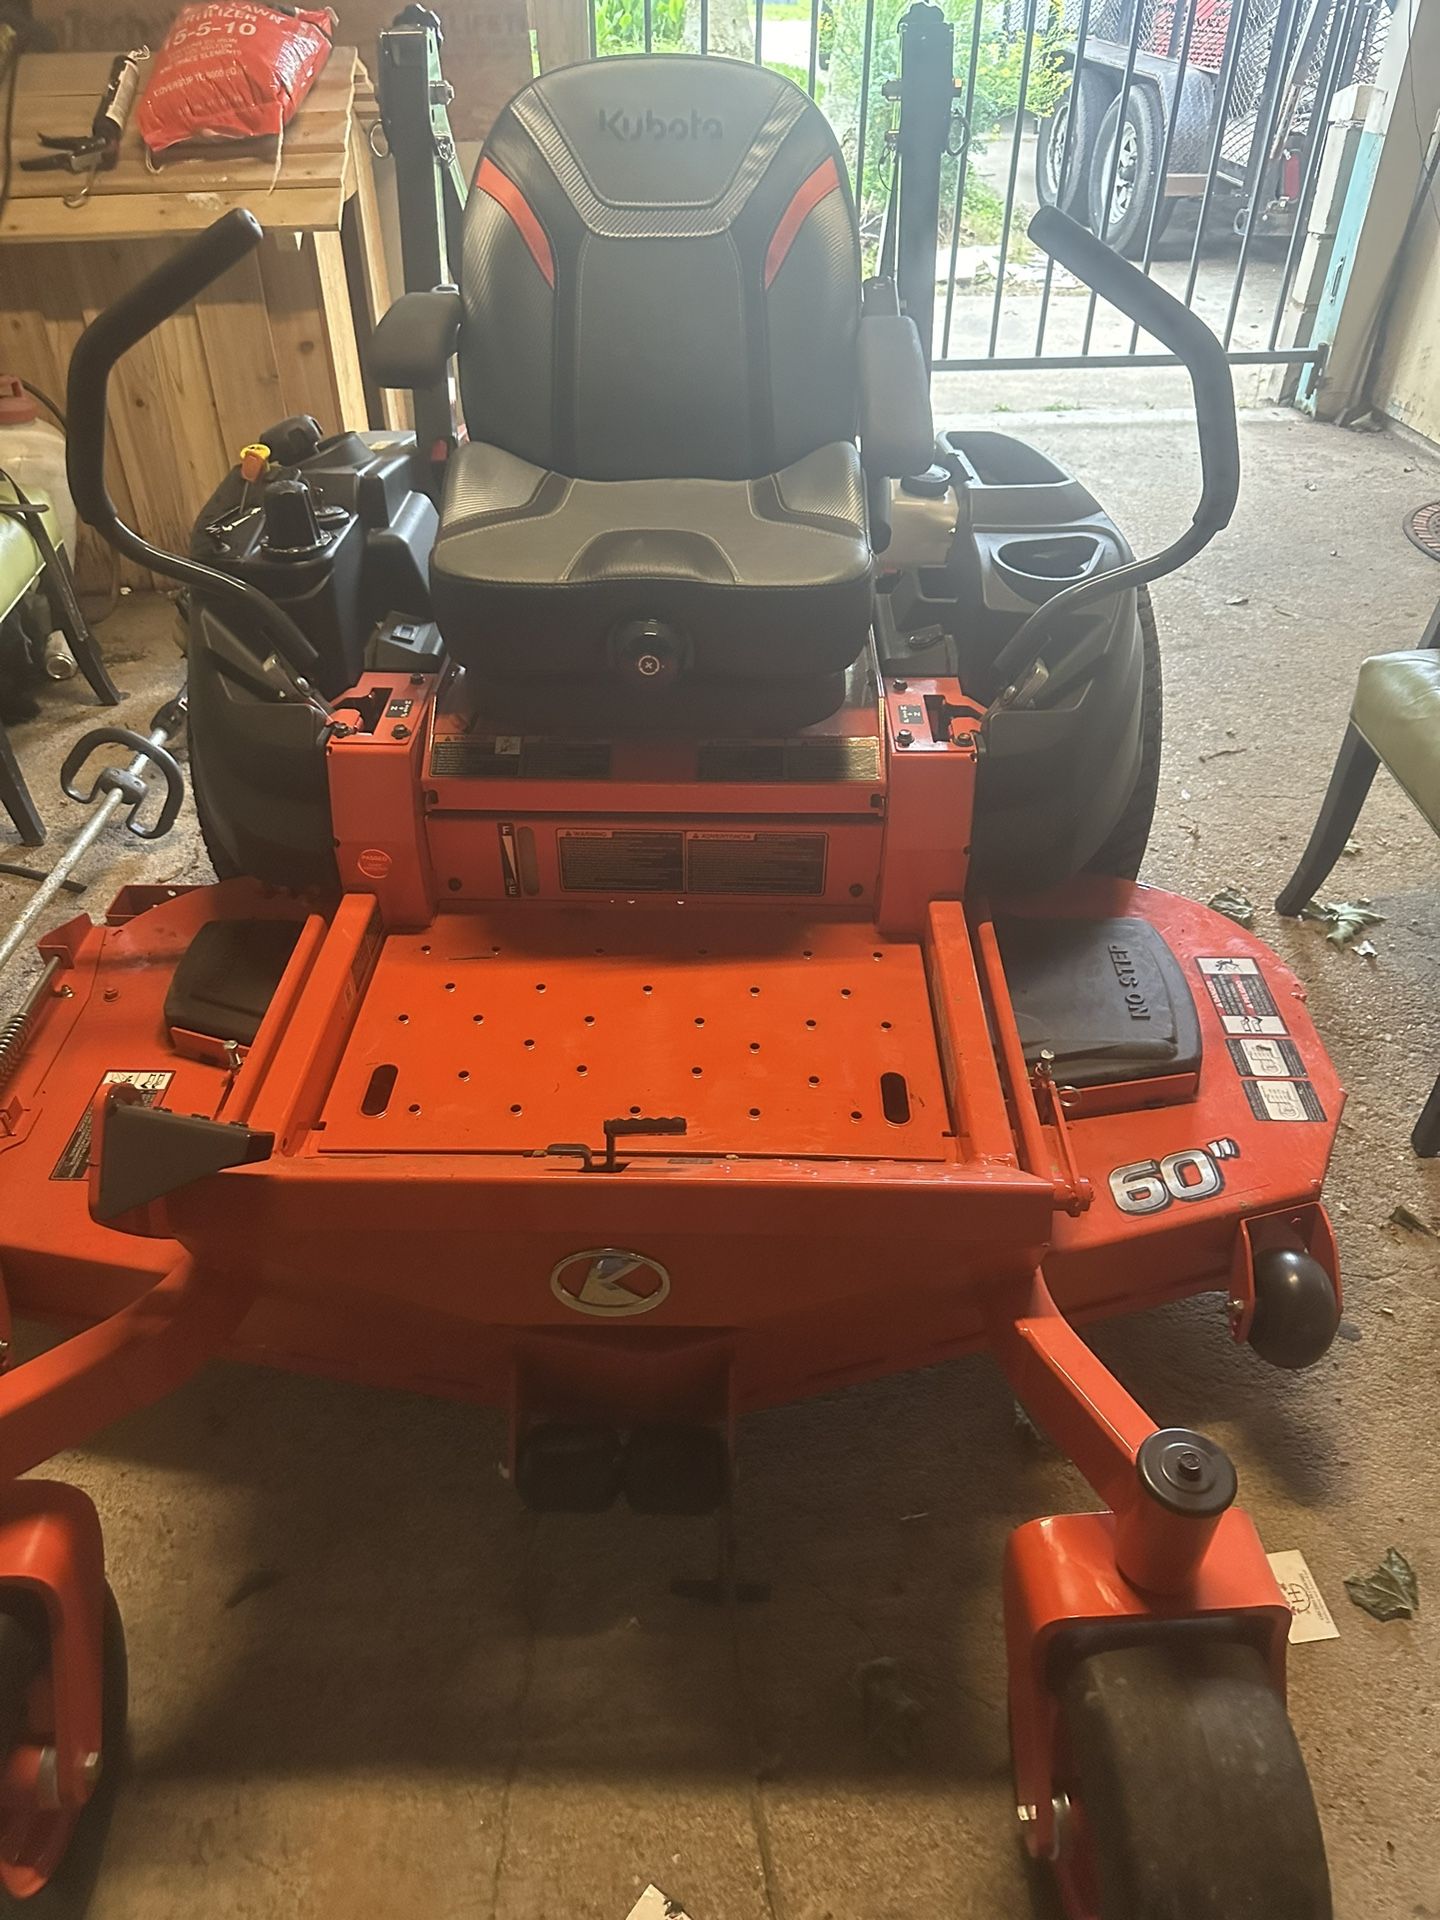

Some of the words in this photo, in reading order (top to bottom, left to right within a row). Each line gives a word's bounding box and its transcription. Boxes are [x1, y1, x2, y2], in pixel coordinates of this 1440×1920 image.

[600, 108, 723, 141] Kubota
[502, 825, 510, 835] F
[508, 885, 517, 895] E
[1107, 944, 1139, 989] STEP
[1205, 980, 1221, 1003] DANGER
[1125, 993, 1151, 1021] NO
